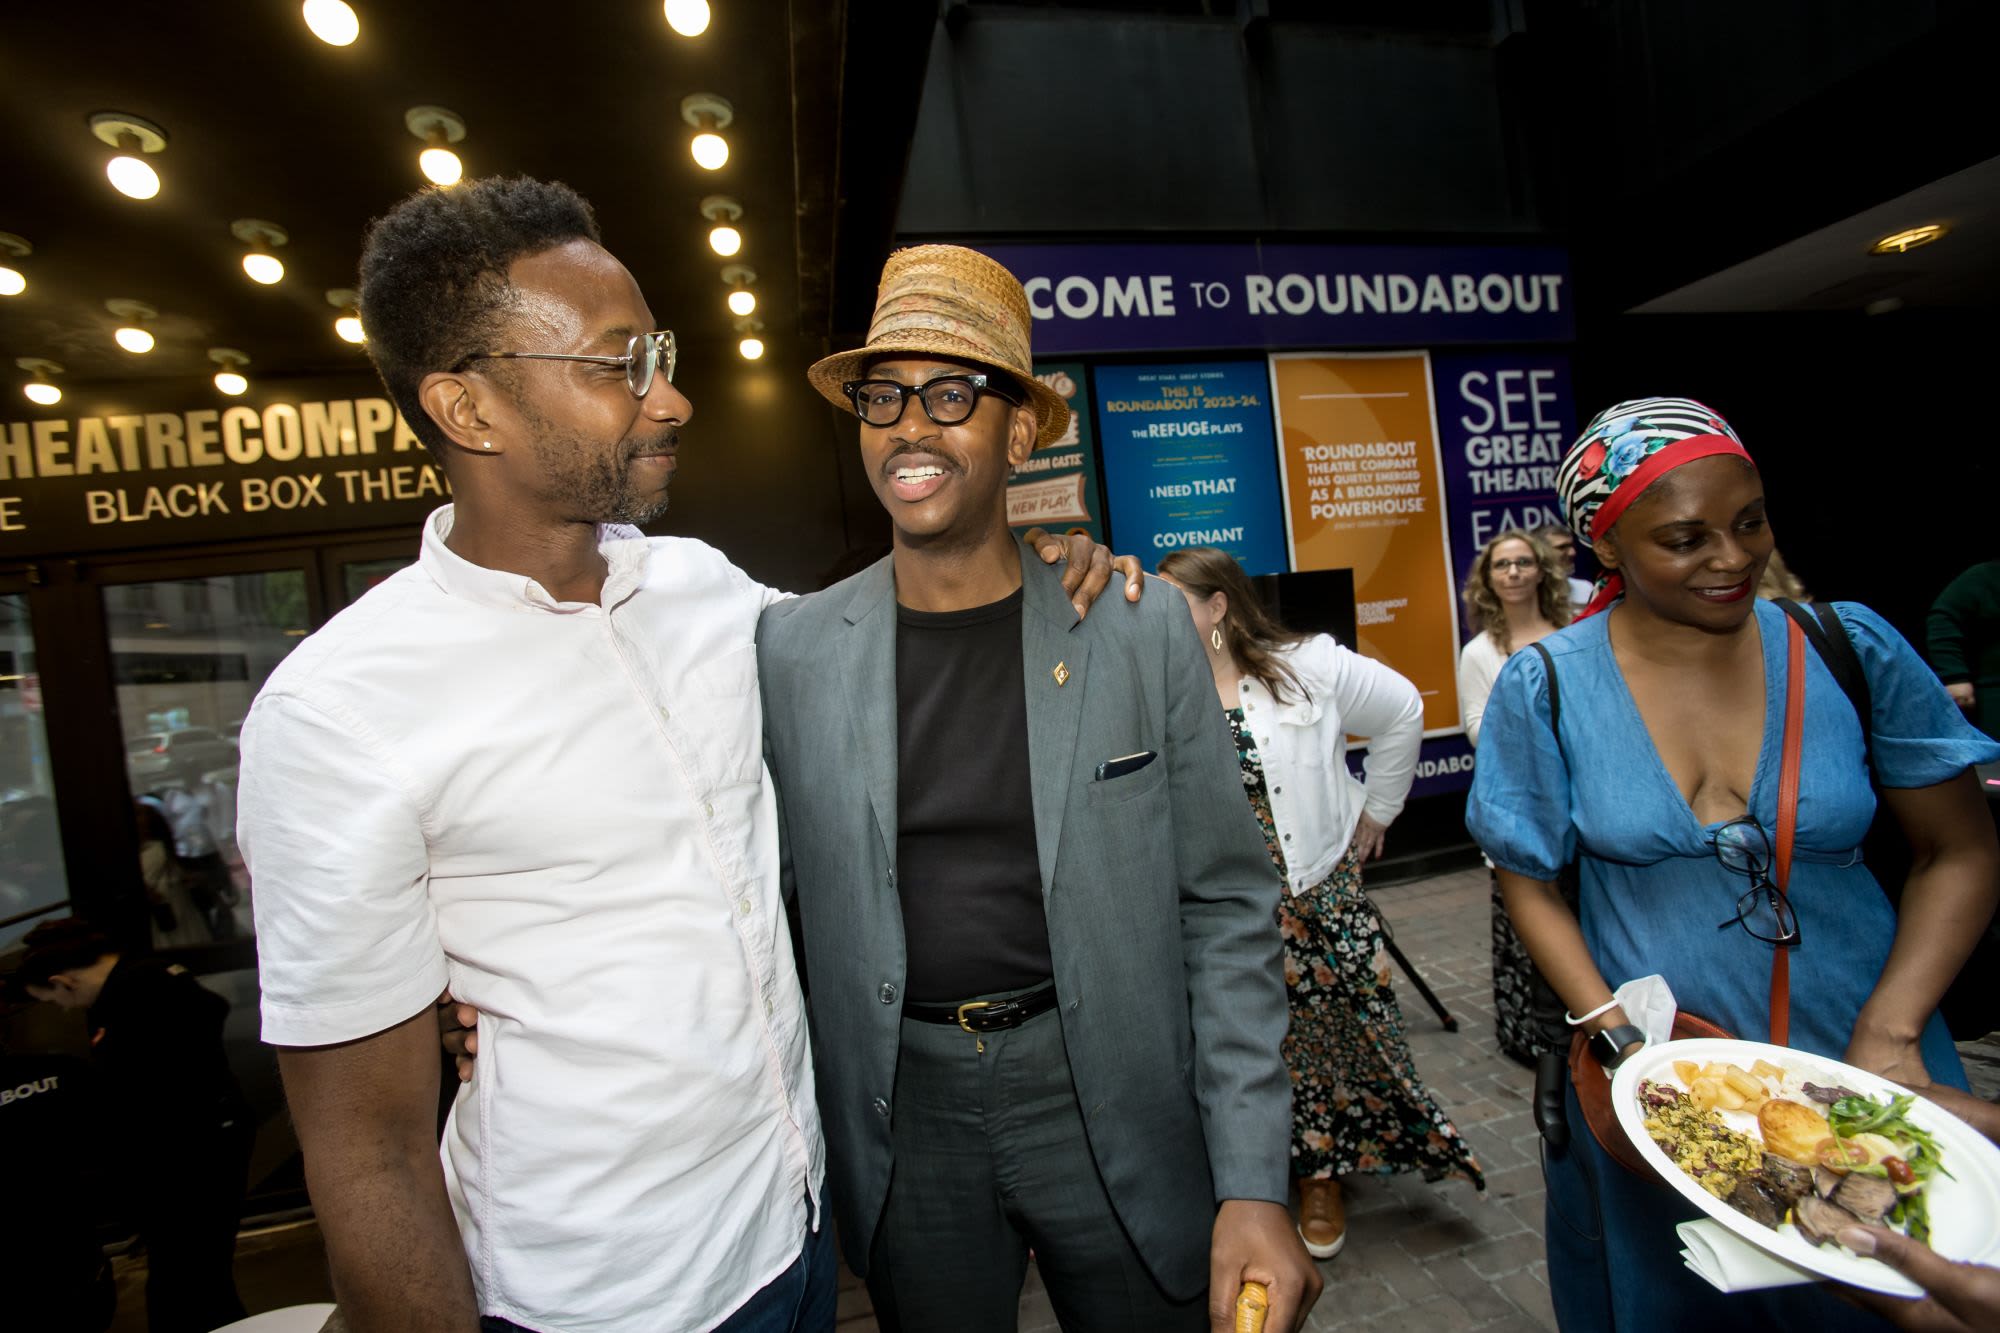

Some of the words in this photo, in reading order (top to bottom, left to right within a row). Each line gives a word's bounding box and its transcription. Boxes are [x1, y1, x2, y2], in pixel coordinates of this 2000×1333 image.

[1190, 282, 1230, 308] TO
[1245, 273, 1562, 315] ROUNDABOUT
[1161, 386, 1189, 398] THIS
[1193, 385, 1205, 396] IS
[1106, 398, 1199, 412] ROUNDABOUT
[1459, 370, 1561, 434] SEE
[1131, 429, 1149, 439] THE
[1149, 421, 1209, 438] REFUGE
[1210, 423, 1243, 434] PLAYS
[1464, 433, 1562, 467] GREAT
[1306, 461, 1357, 475] THEATRE
[1360, 458, 1417, 471] COMPANY
[1150, 488, 1154, 498] I
[1156, 484, 1192, 498] NEED
[1192, 478, 1237, 495] THAT
[1307, 476, 1331, 487] HAS
[1333, 473, 1373, 485] QUIETLY
[1376, 471, 1420, 483] EMERGED
[1468, 466, 1559, 495] THEATR
[85, 481, 230, 524] BLACK
[241, 474, 327, 512] BOX
[1311, 488, 1329, 501] AS
[1333, 488, 1343, 499] A
[1347, 483, 1420, 498] BROADWAY
[1011, 500, 1037, 515] NEW
[1153, 527, 1244, 548] COVENANT
[0, 1076, 58, 1107] BOUT
